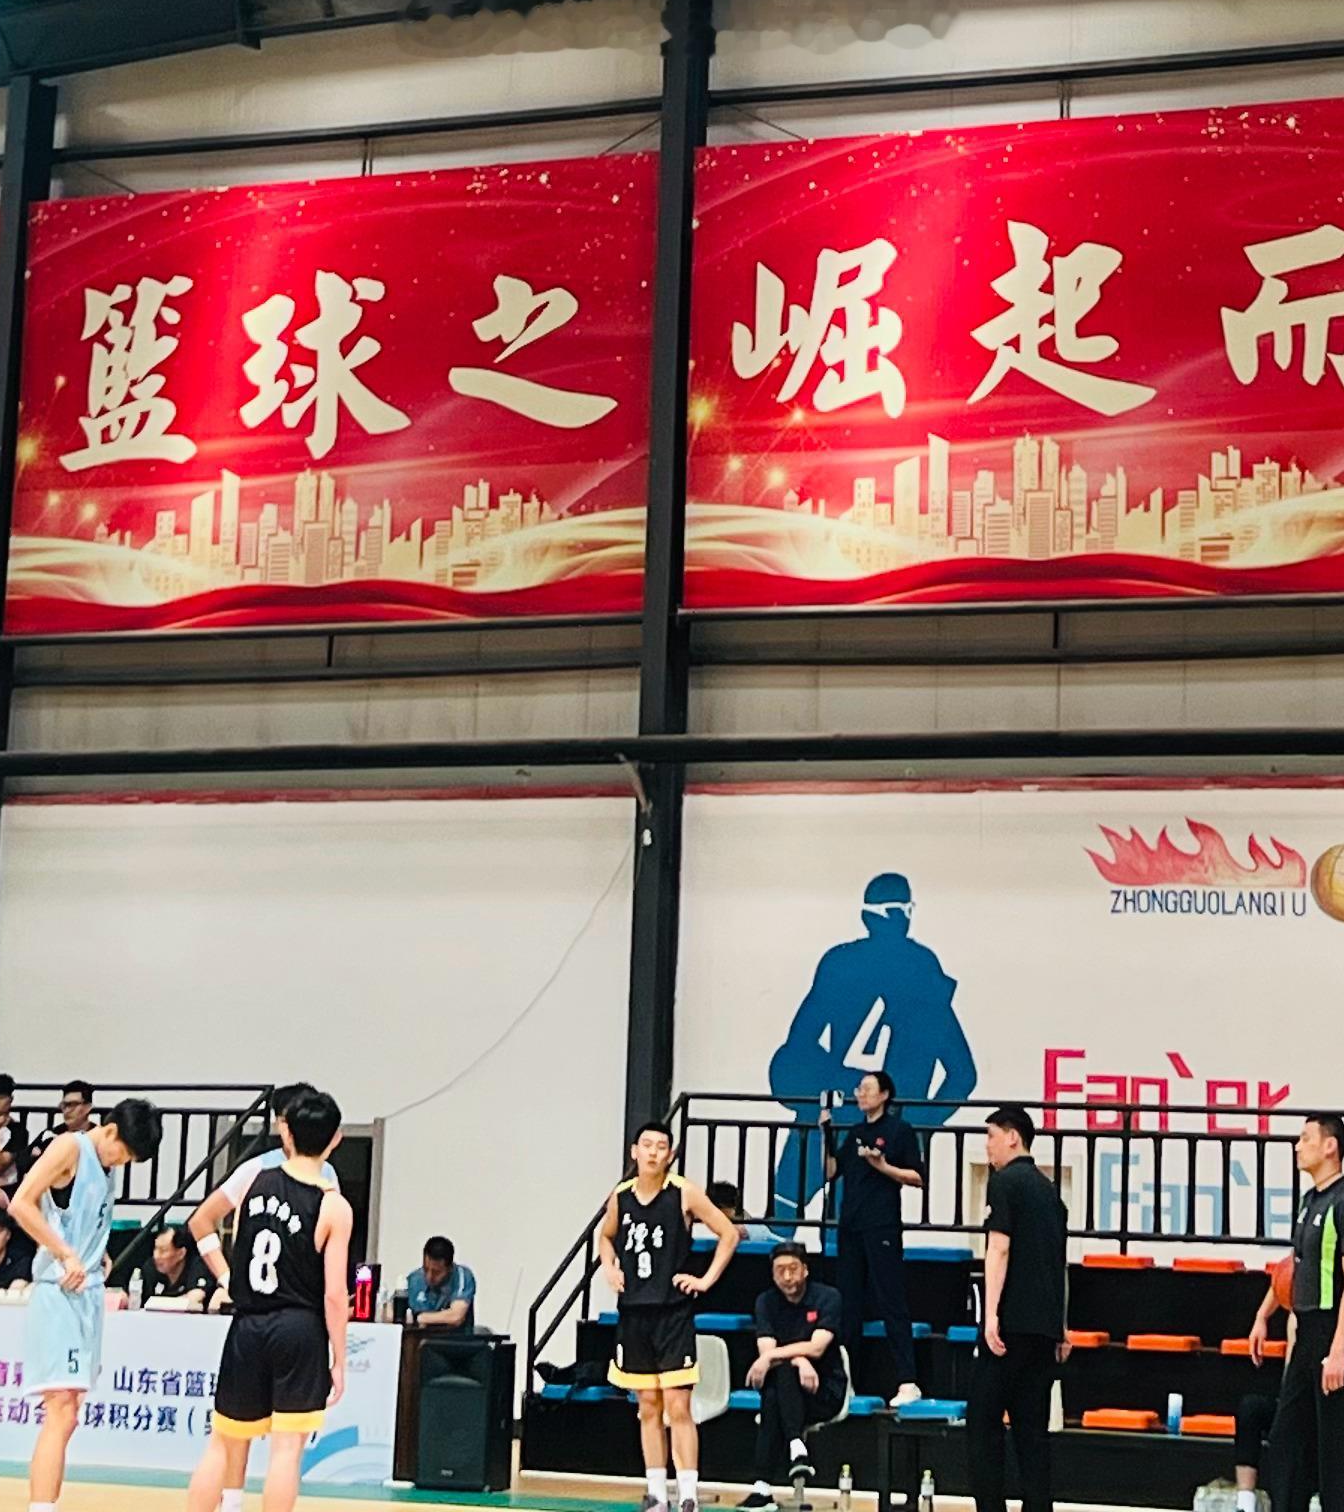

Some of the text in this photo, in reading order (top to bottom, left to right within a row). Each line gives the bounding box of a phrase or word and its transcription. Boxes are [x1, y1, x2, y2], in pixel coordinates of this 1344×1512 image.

[58, 269, 619, 473] 籃球之
[1110, 889, 1307, 917] ZHONGGUOLANQIU
[249, 1228, 282, 1295] 8
[68, 1348, 79, 1374] 5
